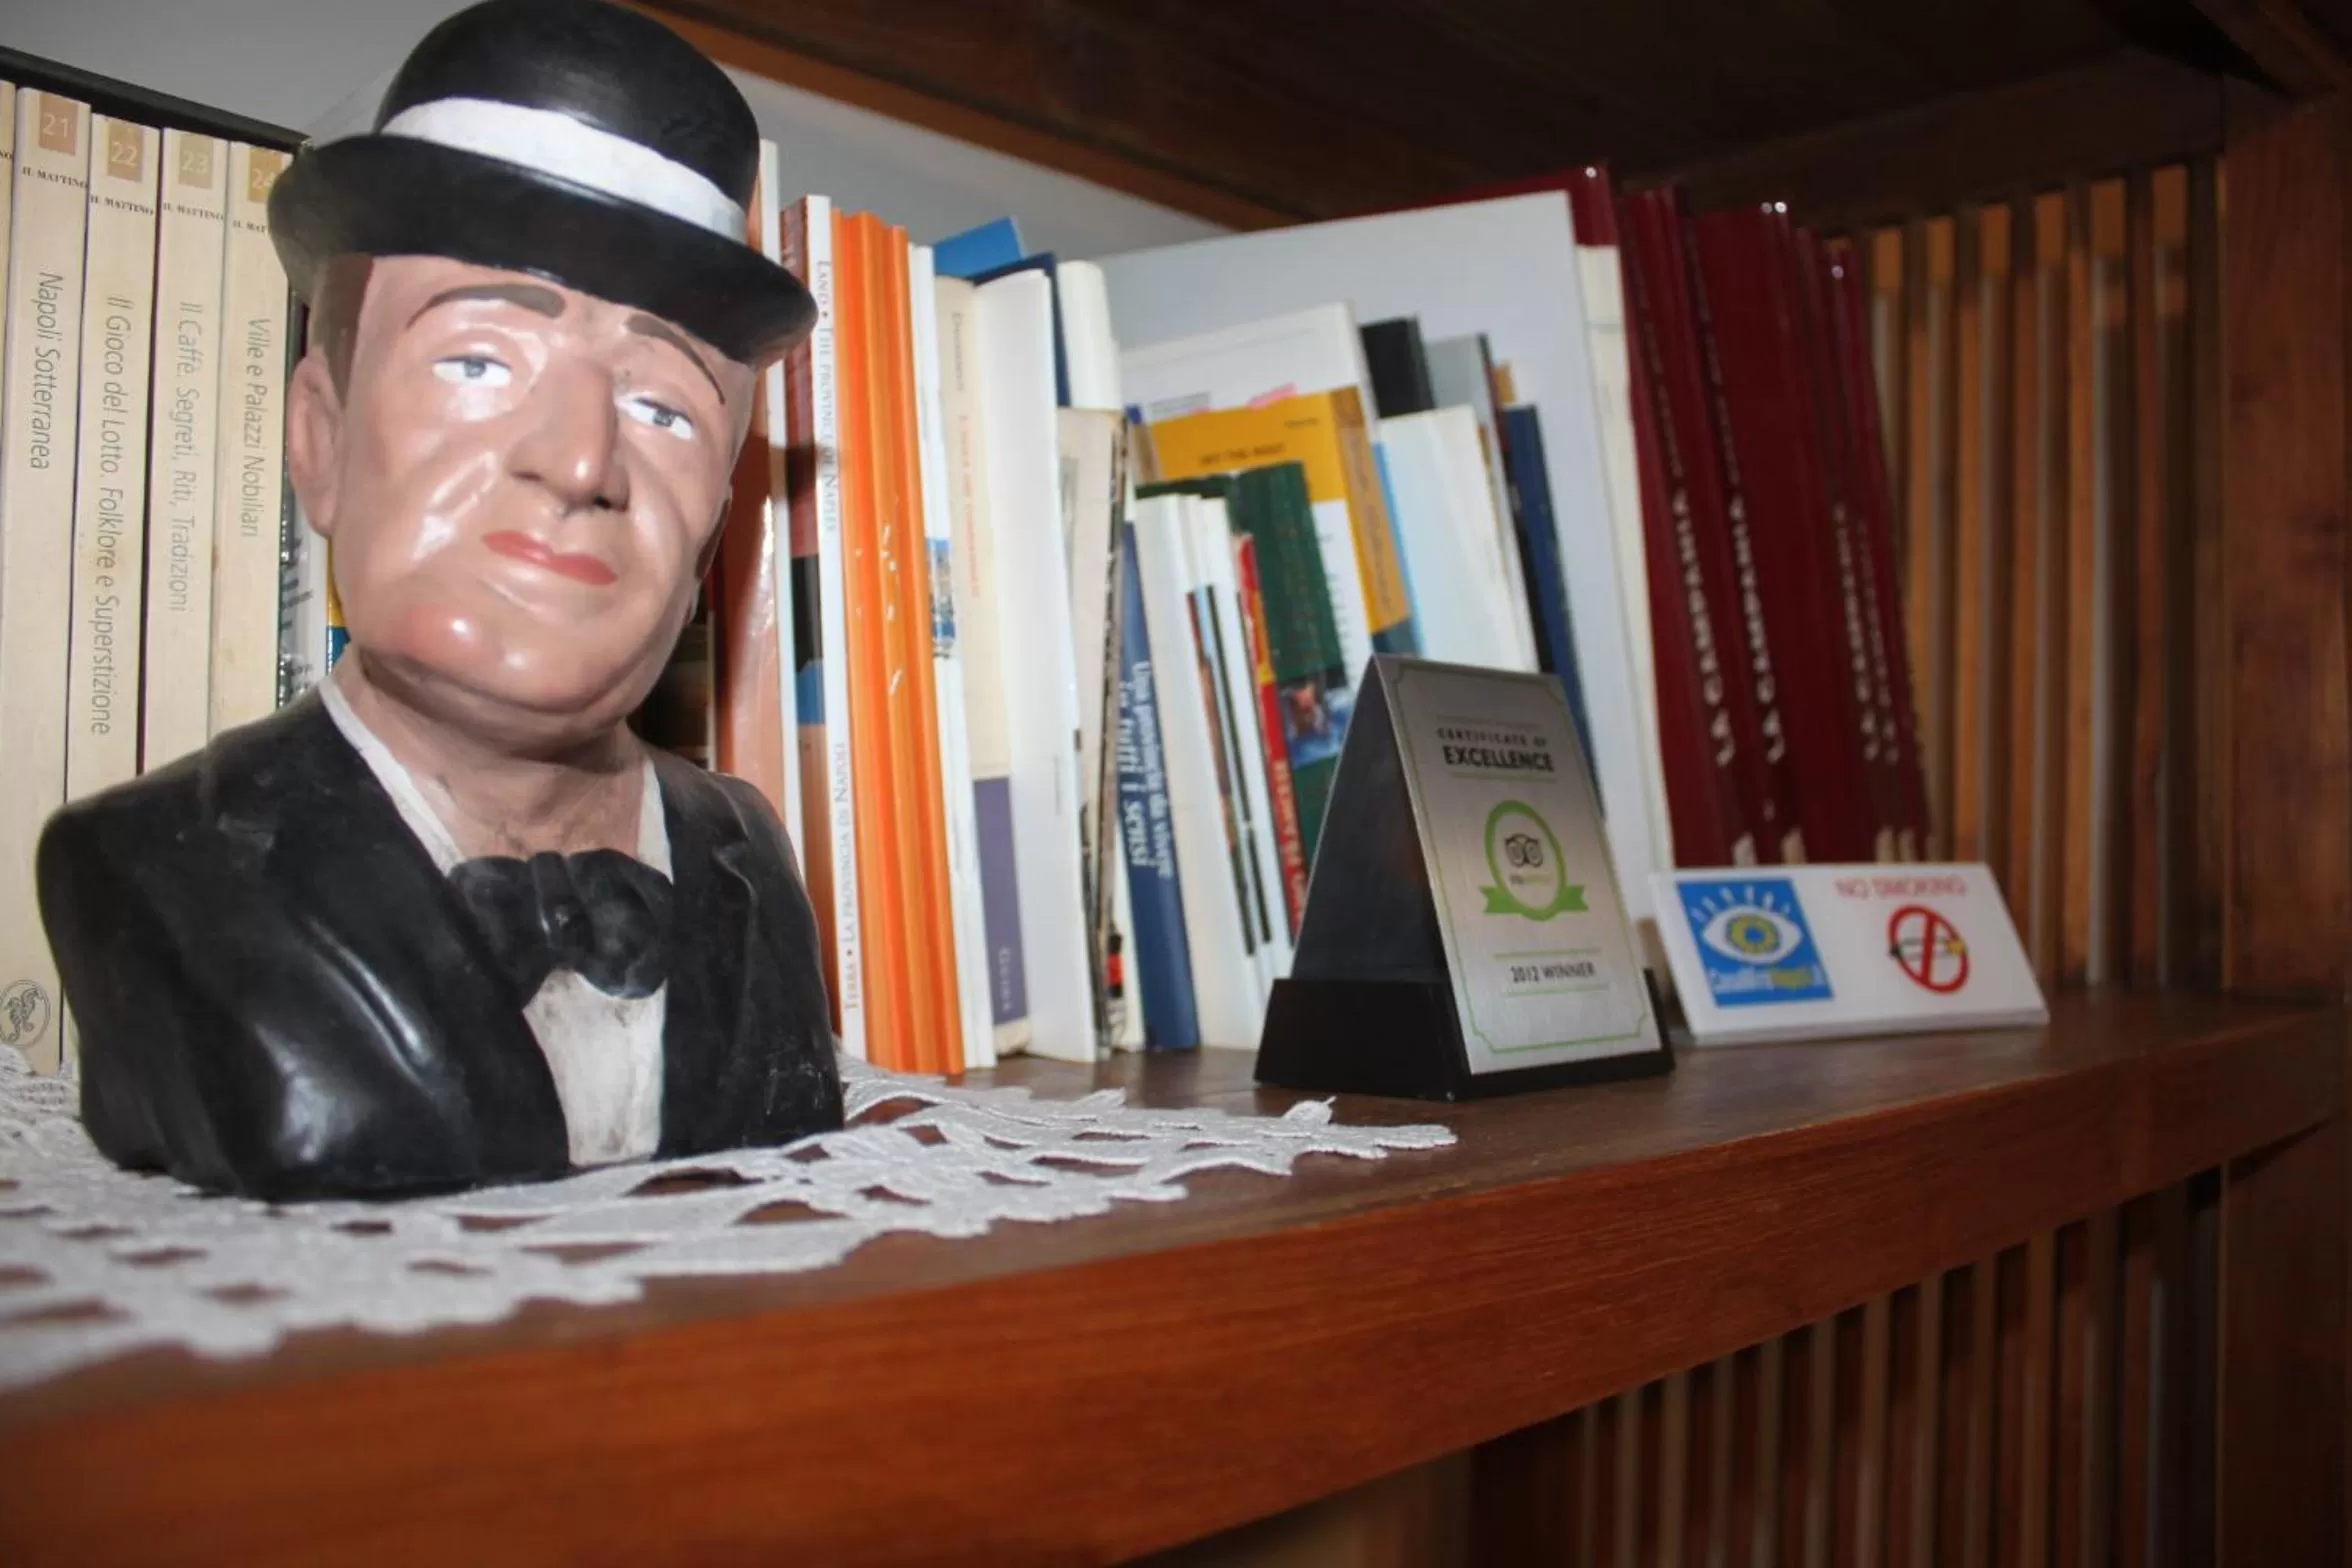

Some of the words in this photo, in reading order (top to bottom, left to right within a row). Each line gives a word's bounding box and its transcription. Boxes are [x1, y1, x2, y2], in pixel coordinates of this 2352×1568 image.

[42, 112, 70, 139] 21
[110, 141, 139, 168] 22
[180, 149, 210, 174] 23
[103, 197, 155, 217] MATTINO
[29, 271, 64, 342] Napoli
[106, 296, 135, 310] Il
[179, 301, 204, 314] Il
[104, 315, 132, 376] Gioco
[246, 318, 272, 359] Ville
[245, 364, 264, 377] e
[30, 345, 61, 470] Sotterranea
[102, 382, 129, 414] del
[243, 382, 270, 449] Palazzi
[100, 419, 126, 478] Lotto.
[168, 470, 198, 506] Riti,
[240, 454, 265, 538] Nobiliari
[96, 487, 125, 569] Folklore
[168, 515, 196, 613] Tradizioni
[95, 575, 115, 588] e
[88, 595, 121, 735] Superstizione
[1435, 726, 1528, 748] CERTIFICATE
[1441, 744, 1556, 773] EXCELLENCE
[1832, 877, 1868, 899] NO
[1870, 874, 1968, 899] SMOKING
[1508, 964, 1540, 984] 2012
[1541, 961, 1596, 980] WINNER
